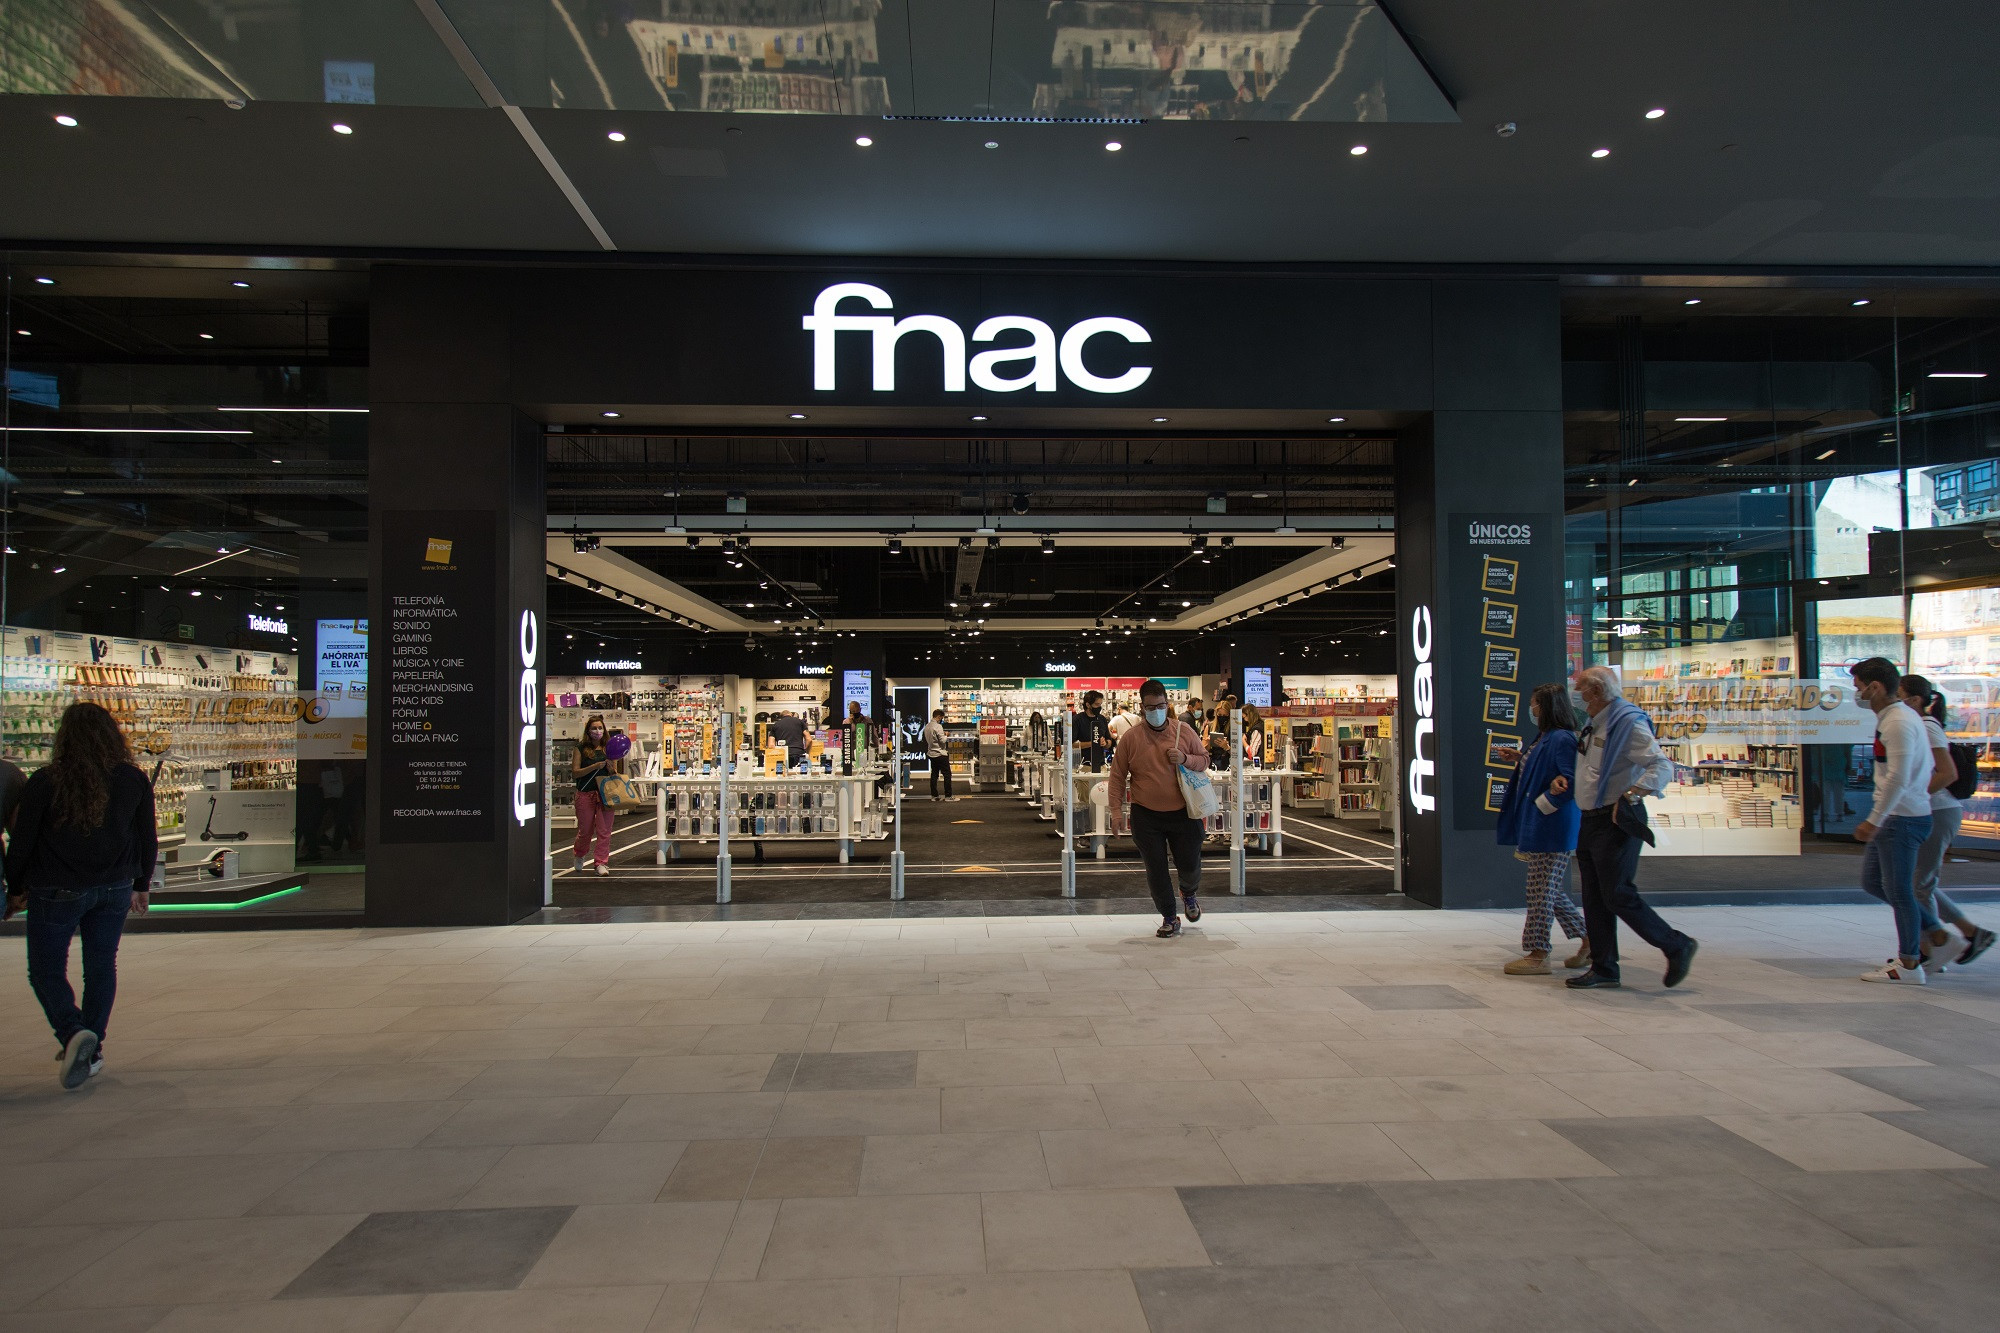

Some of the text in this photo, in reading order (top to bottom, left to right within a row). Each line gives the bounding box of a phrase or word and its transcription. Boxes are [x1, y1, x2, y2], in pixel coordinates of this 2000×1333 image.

[803, 282, 1153, 393] fnac
[1469, 521, 1531, 538] ÚNICOS
[427, 542, 452, 551] fnac
[393, 594, 445, 605] TELEFONÍA
[393, 608, 458, 618] INFORMÁTICA
[248, 614, 288, 635] Telefonía
[393, 622, 431, 630] SONIDO
[1617, 623, 1641, 637] Libros
[393, 634, 432, 642] GAMING
[321, 651, 369, 660] AHÓRRATE
[393, 646, 428, 655] LIBROS
[331, 660, 341, 668] EL
[393, 657, 465, 668] MÚSICA Y CINE
[586, 660, 642, 670] Informática
[1045, 663, 1076, 672] Sonido
[393, 669, 444, 680] PAPELERÍA
[799, 665, 826, 675] Home
[393, 683, 474, 693] MERCHANDISING
[773, 683, 809, 691] ASPIRACIÓN
[392, 696, 444, 705] FNAC KIDS
[392, 707, 428, 718] FÓRUM
[1409, 605, 1436, 815] fnac
[513, 609, 537, 827] fnac
[392, 721, 422, 730] HOME
[1653, 714, 1708, 740] IGO
[313, 731, 342, 740] MÚSICA
[392, 732, 459, 743] CLÍNICA FNAC
[393, 808, 482, 817] RECOGIDA www.fnac.es
